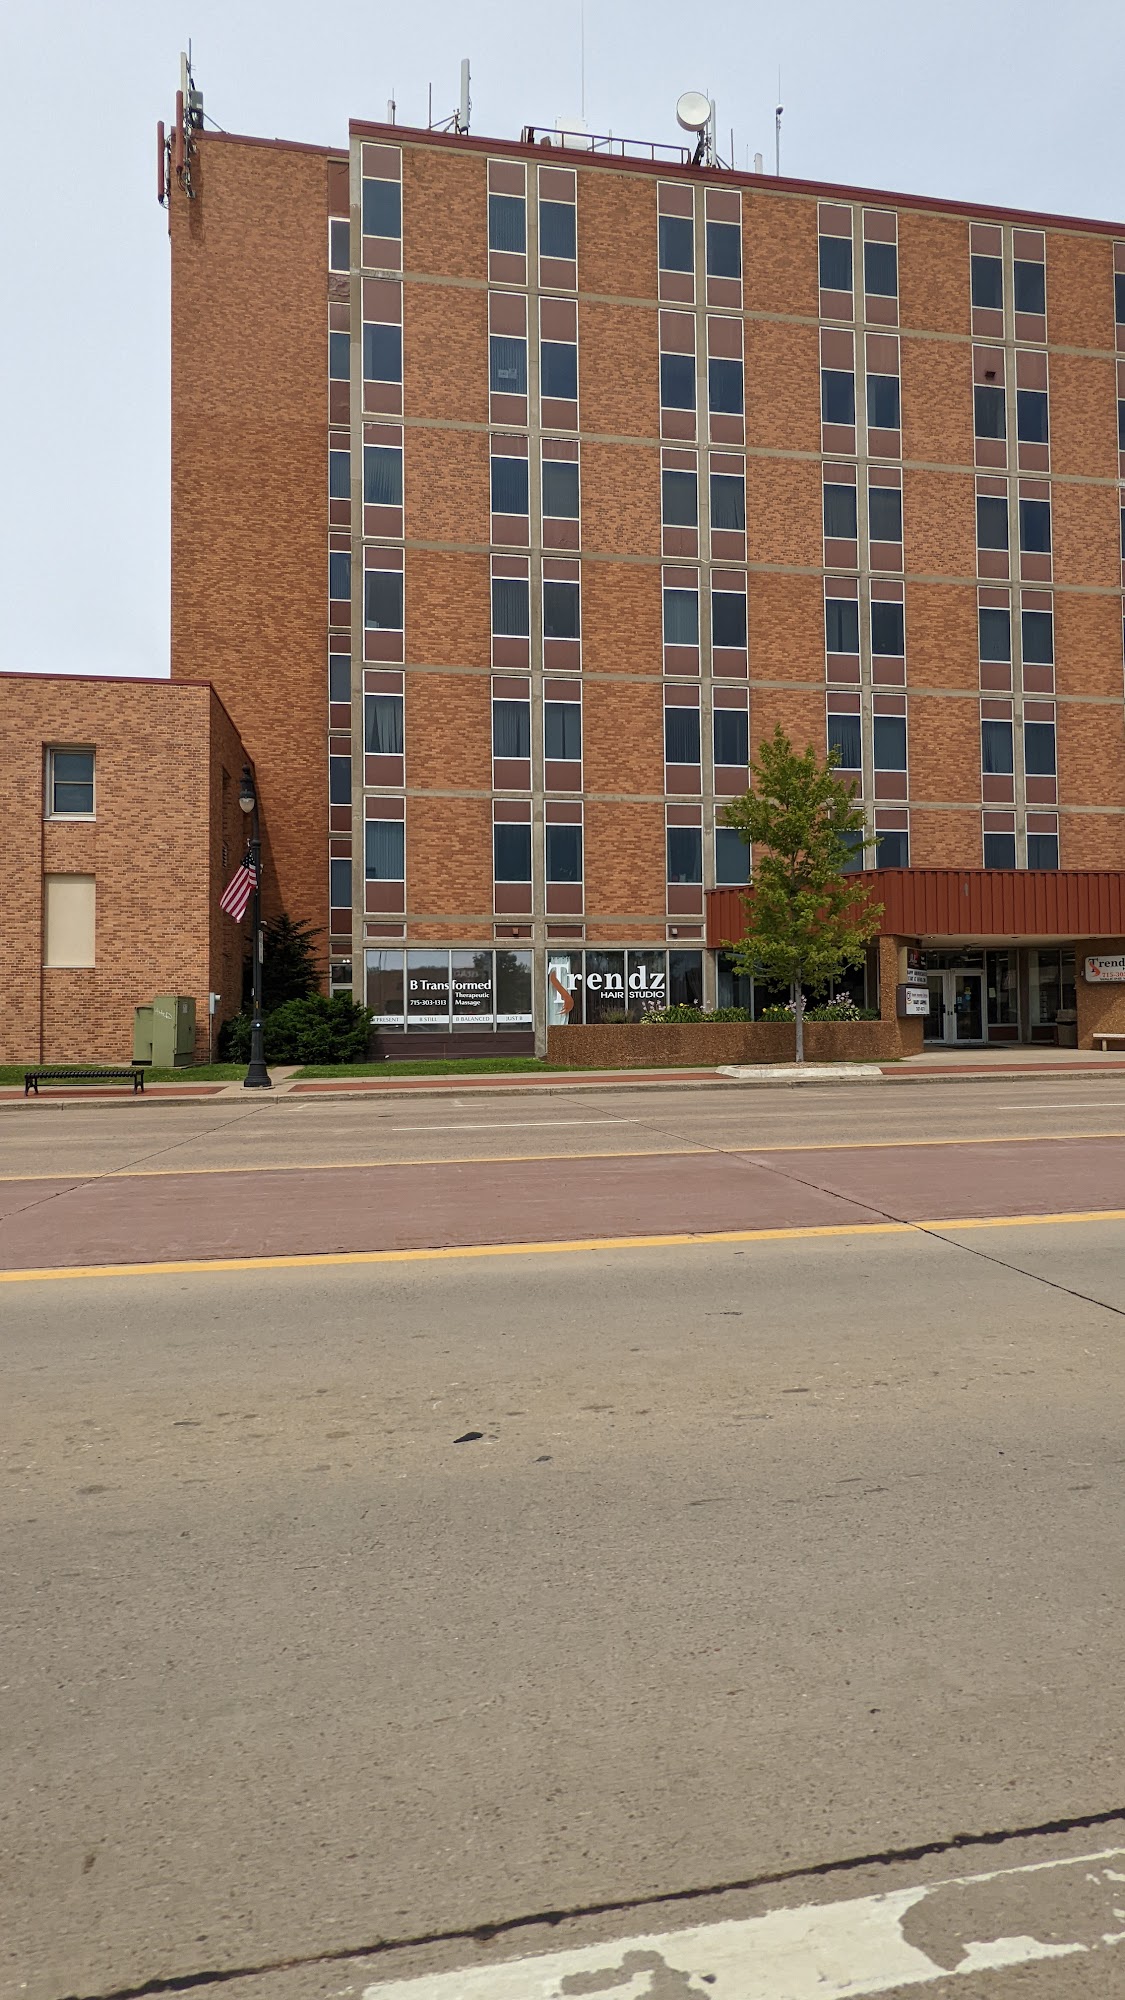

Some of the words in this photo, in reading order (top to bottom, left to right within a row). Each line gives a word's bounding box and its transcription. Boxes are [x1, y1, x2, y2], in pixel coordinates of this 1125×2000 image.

[410, 979, 418, 990] B
[420, 979, 491, 990] Transformed
[548, 962, 665, 1004] Trendz
[600, 991, 624, 999] HAIR
[629, 991, 665, 999] STUDIO
